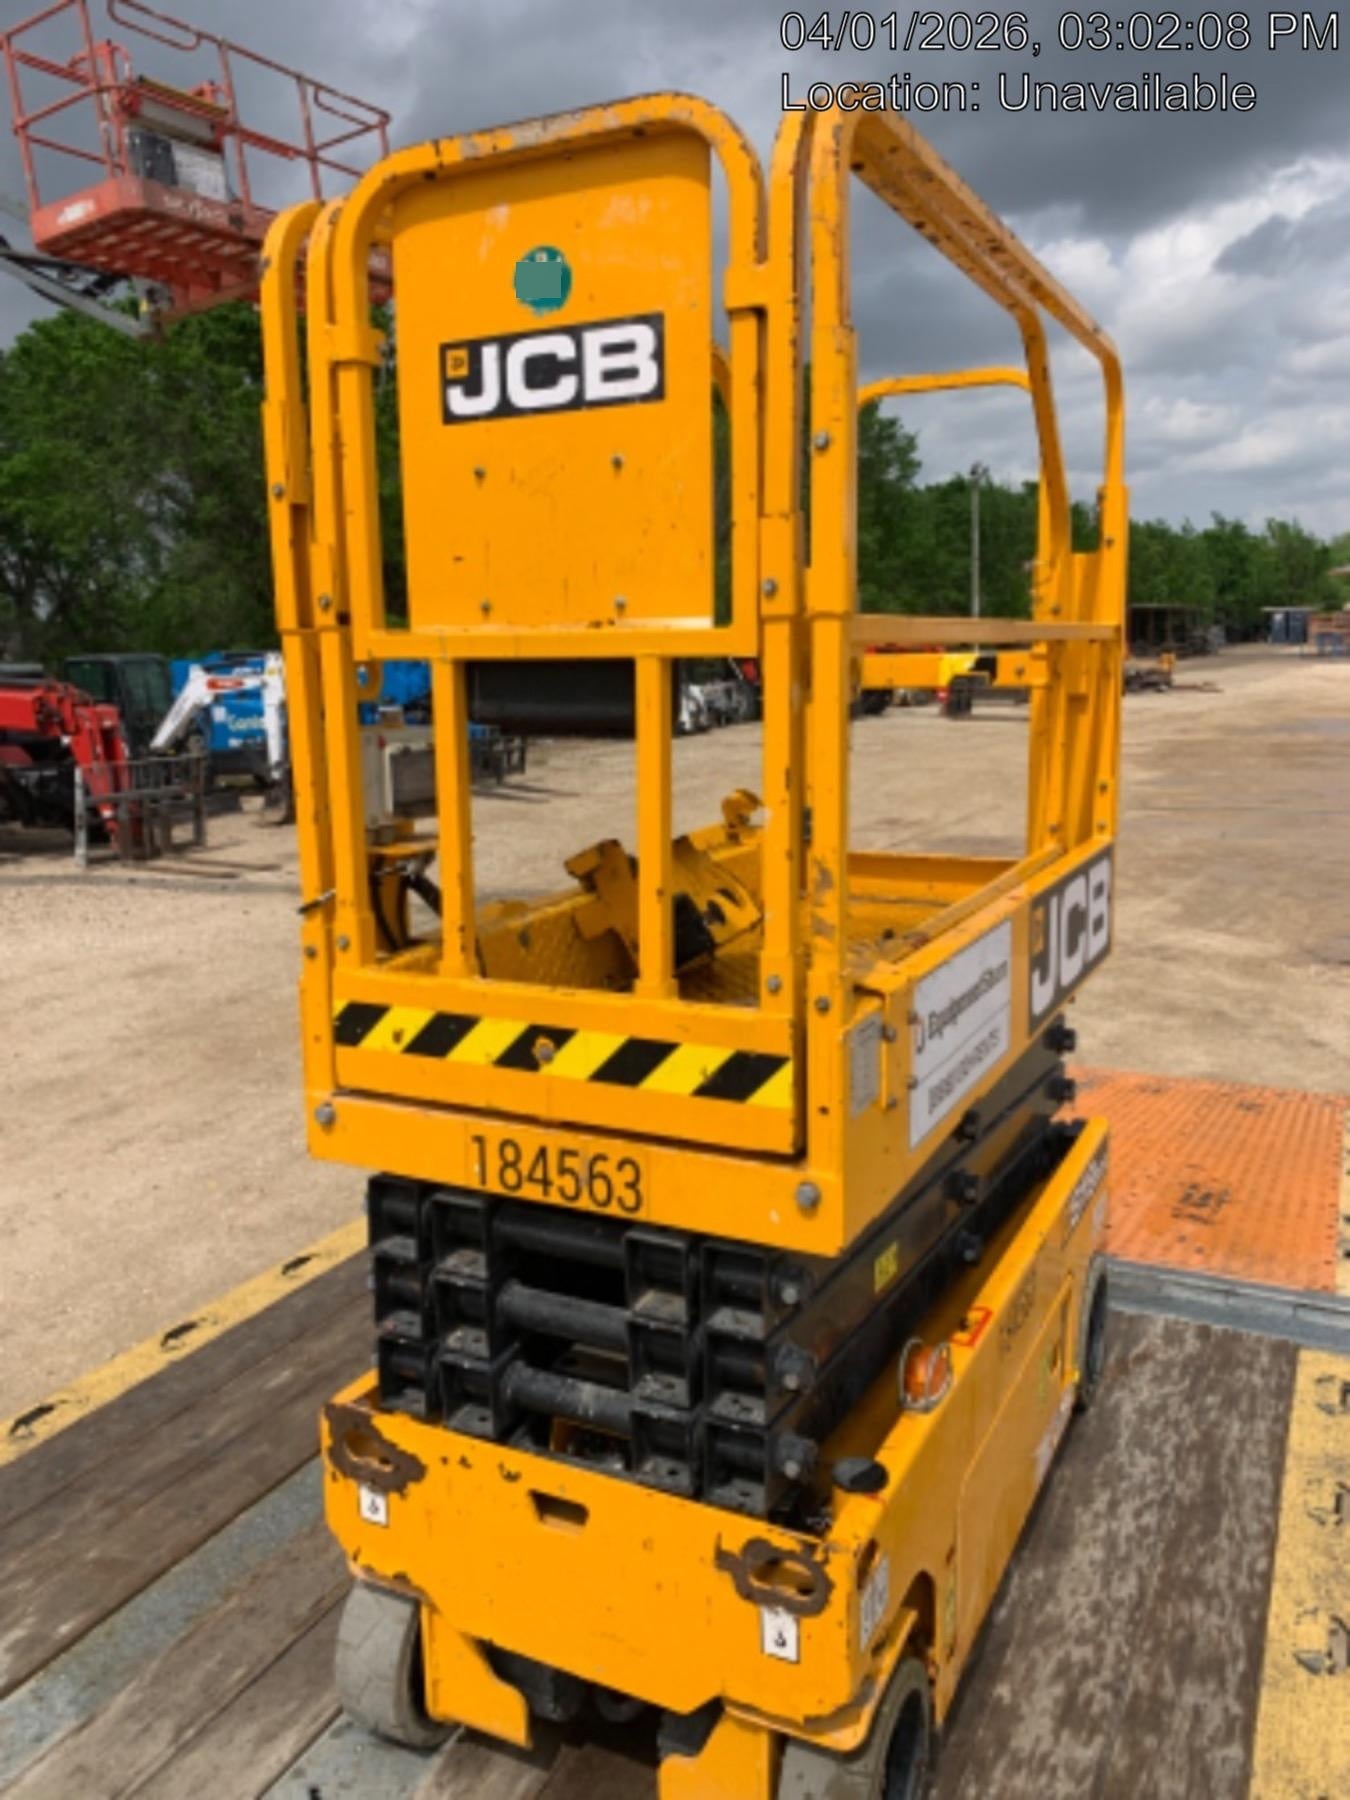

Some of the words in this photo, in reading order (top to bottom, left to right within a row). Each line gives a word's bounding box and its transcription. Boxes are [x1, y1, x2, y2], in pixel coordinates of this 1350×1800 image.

[445, 323, 659, 417] JCB
[1031, 856, 1111, 1018] JCB
[471, 1134, 644, 1215] 184563
